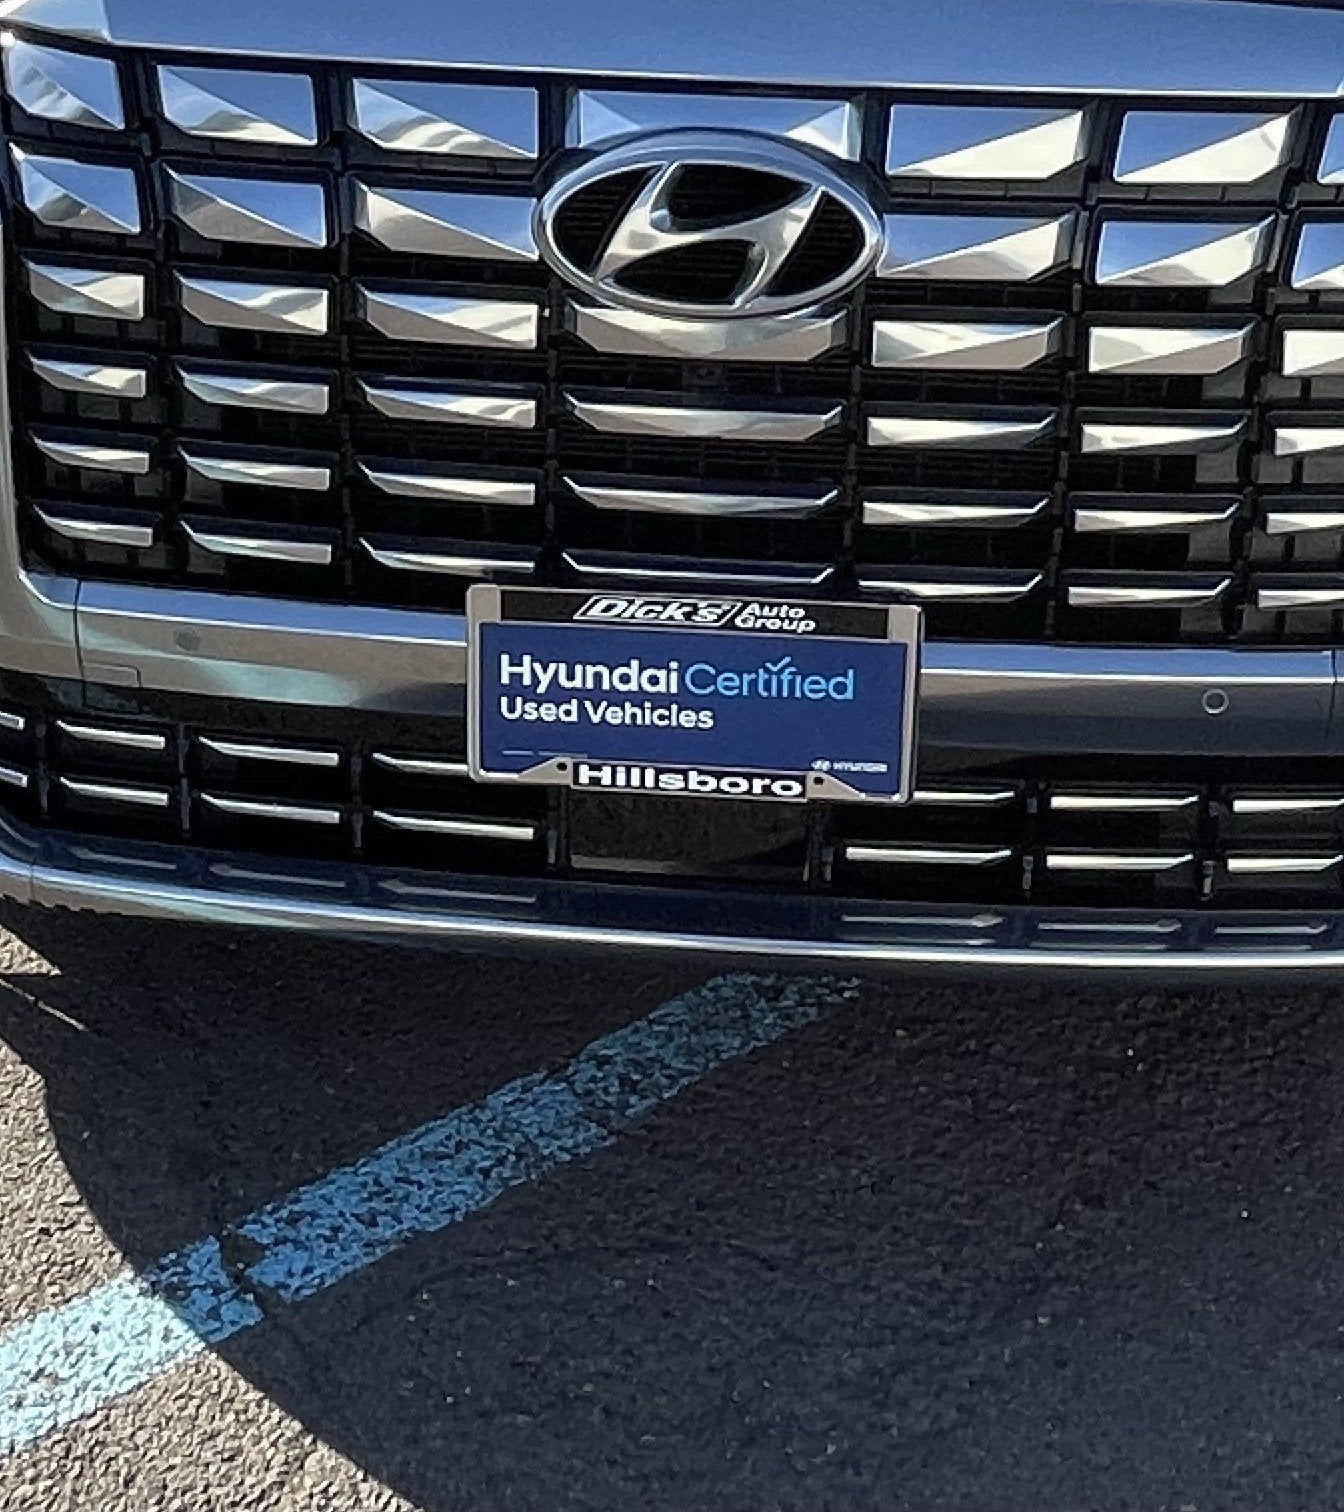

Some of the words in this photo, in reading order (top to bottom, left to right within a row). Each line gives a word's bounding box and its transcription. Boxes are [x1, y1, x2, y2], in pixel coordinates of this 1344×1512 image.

[734, 616, 816, 633] Group
[742, 602, 806, 619] Auto
[499, 653, 679, 695] Hyundai
[684, 656, 855, 700] Certified
[499, 696, 578, 722] Used
[585, 700, 715, 729] Vehicles
[578, 764, 803, 796] Hillsboro
